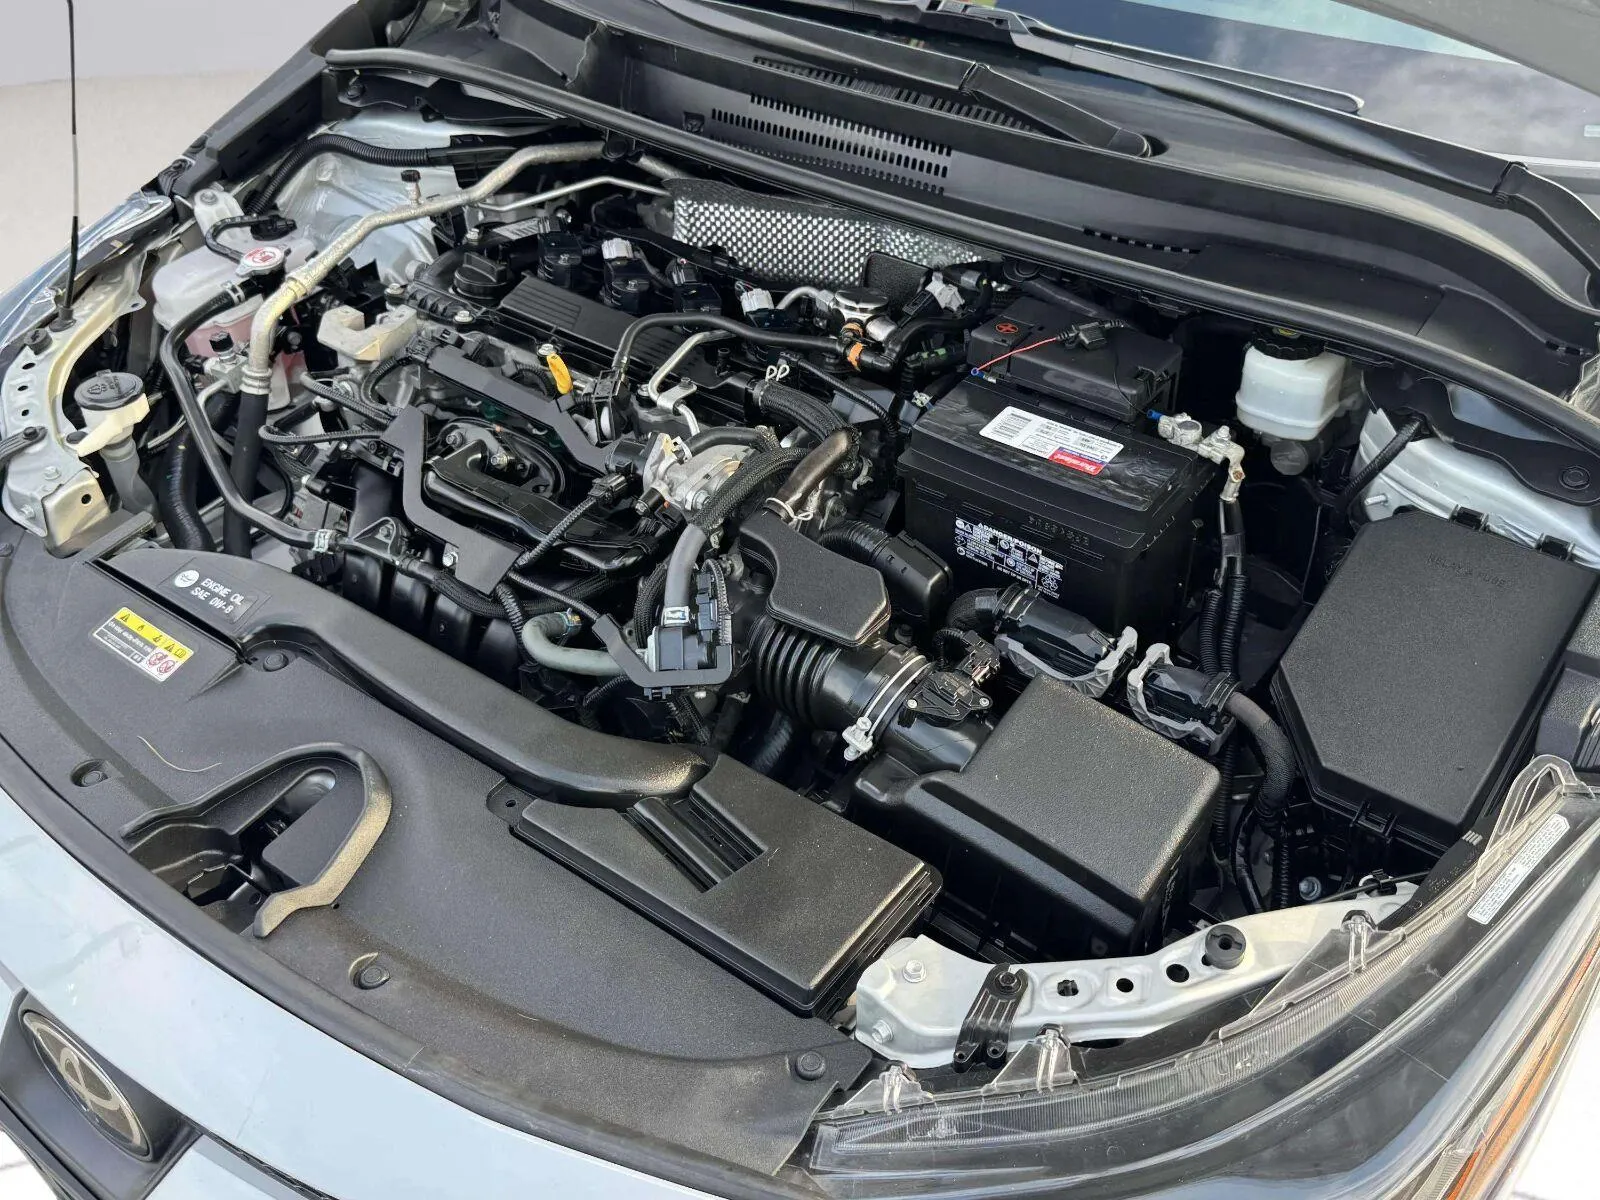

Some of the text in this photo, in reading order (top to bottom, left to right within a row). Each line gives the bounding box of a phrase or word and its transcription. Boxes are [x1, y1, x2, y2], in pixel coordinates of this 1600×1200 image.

[190, 587, 234, 614] SAE 0W-8
[200, 578, 245, 606] ENGINE OIL
